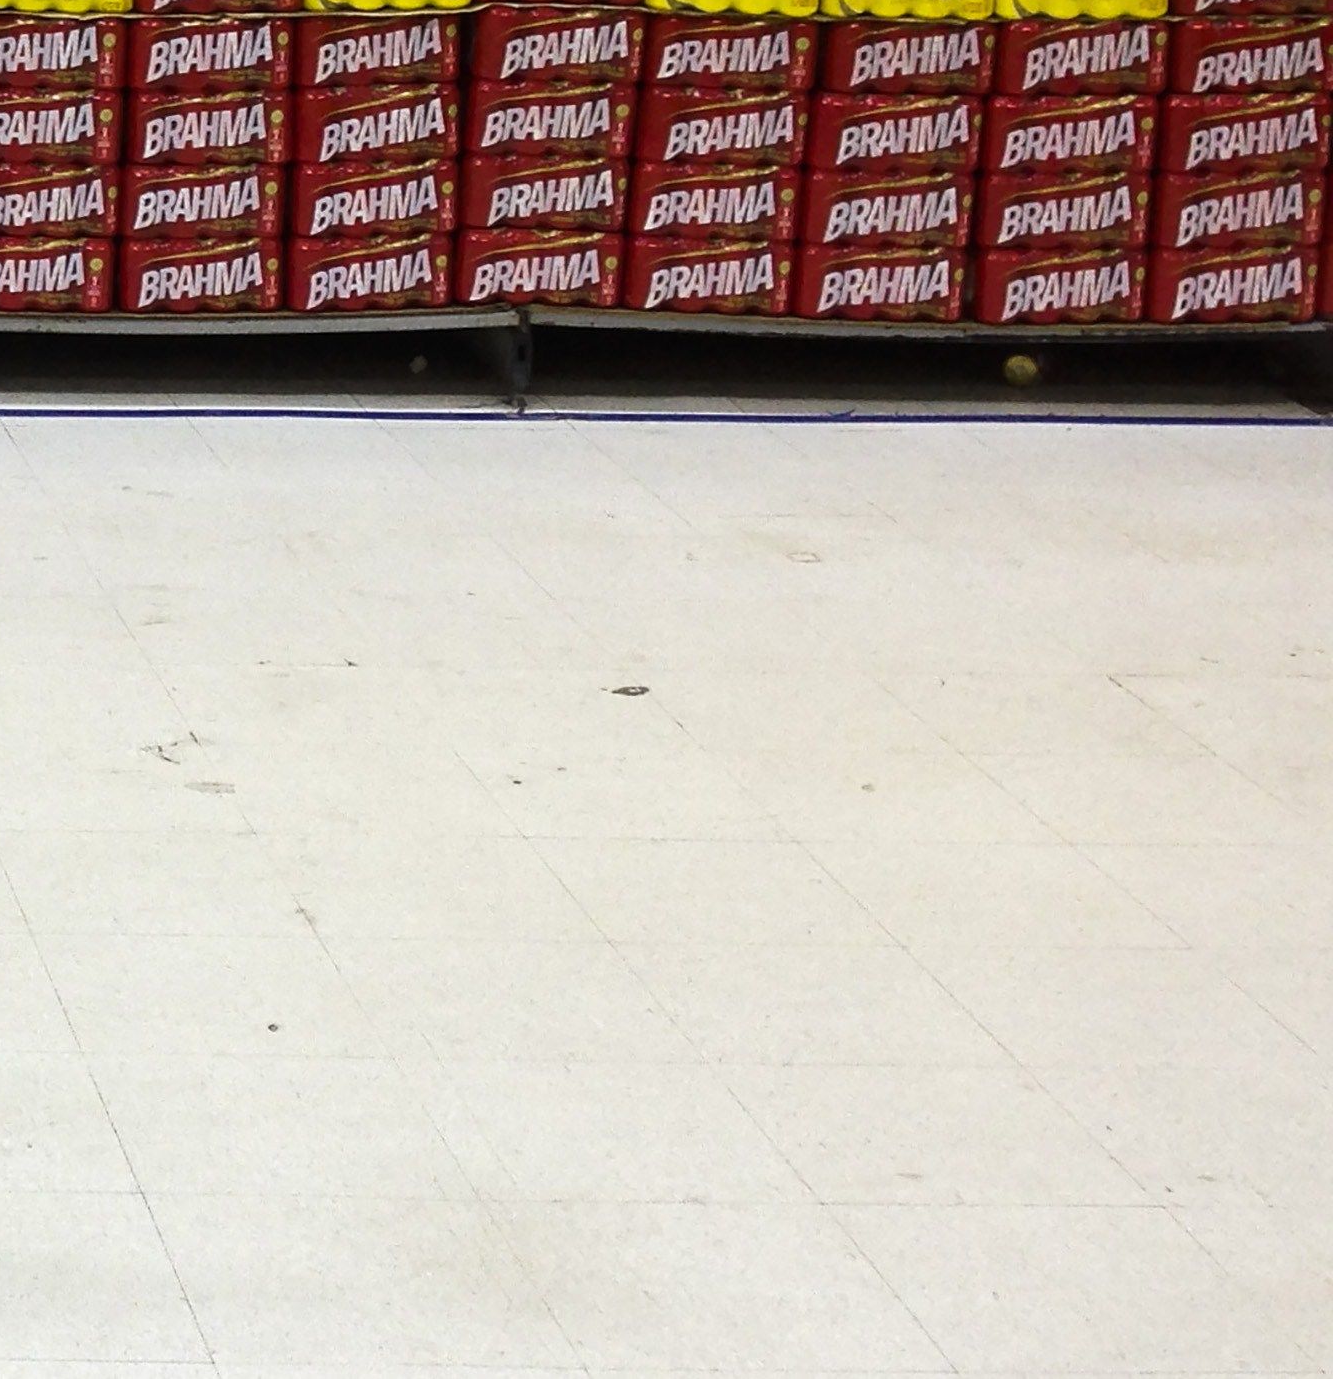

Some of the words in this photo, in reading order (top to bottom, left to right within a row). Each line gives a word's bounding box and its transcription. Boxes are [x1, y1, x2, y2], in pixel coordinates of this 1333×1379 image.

[147, 22, 273, 82] BRAHMA
[657, 31, 789, 78] BRAHMA
[1193, 38, 1324, 92] BRAHMA
[320, 98, 445, 161] BRAHMA
[1001, 111, 1135, 168] BRAHMA
[134, 176, 259, 229] BRAHMA
[644, 182, 775, 230] BRAHMA
[306, 249, 432, 309] BRAHMA
[817, 260, 949, 312] BRAHMA
[1172, 258, 1302, 319] BRAHMA
